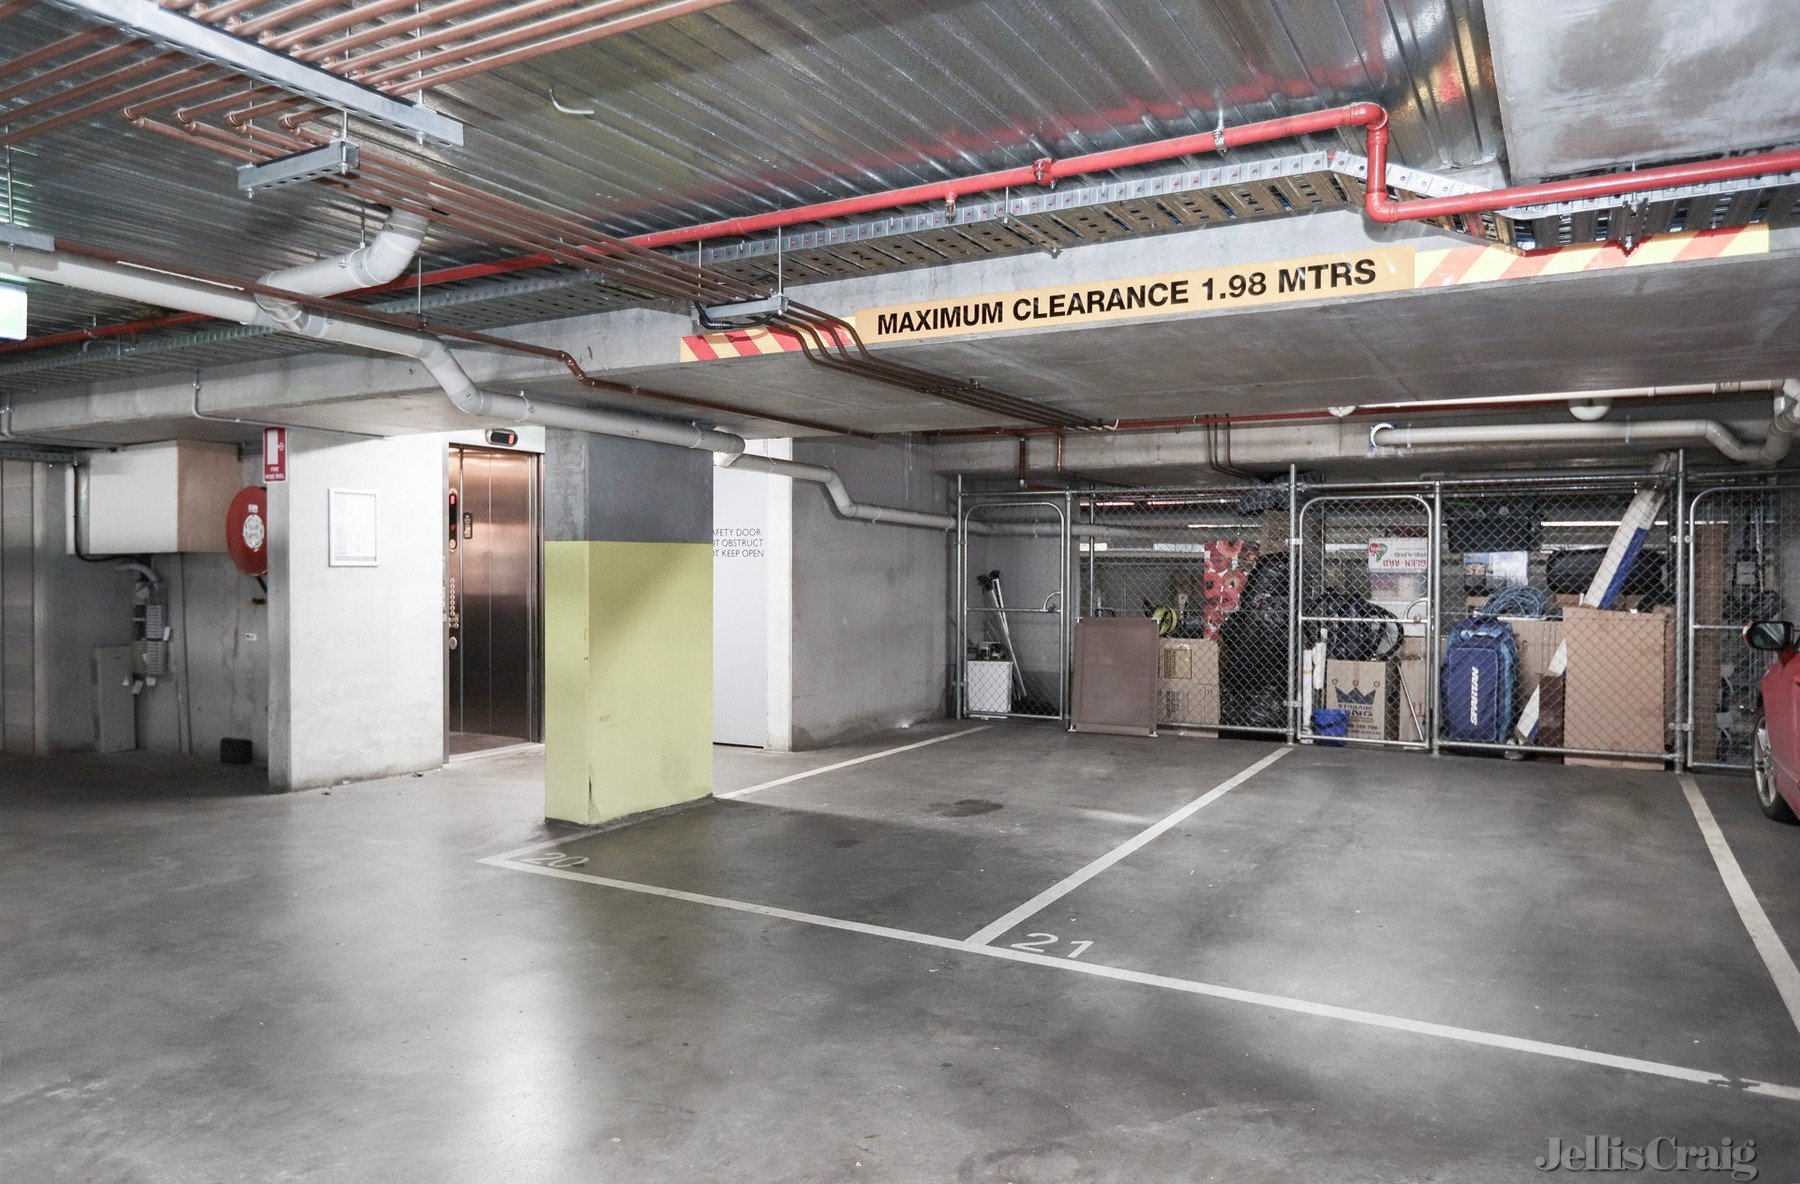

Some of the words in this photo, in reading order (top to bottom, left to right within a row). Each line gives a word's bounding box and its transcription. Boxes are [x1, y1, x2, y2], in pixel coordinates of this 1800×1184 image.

[877, 301, 1003, 335] MAXIMUM
[1012, 280, 1189, 321] CLEARANCE
[1202, 272, 1267, 300] 1.98
[1278, 258, 1376, 294] MTRS
[736, 528, 762, 536] DOOR
[721, 539, 764, 547] OBSTRUCT
[520, 852, 590, 868] 20
[1010, 932, 1094, 958] 21
